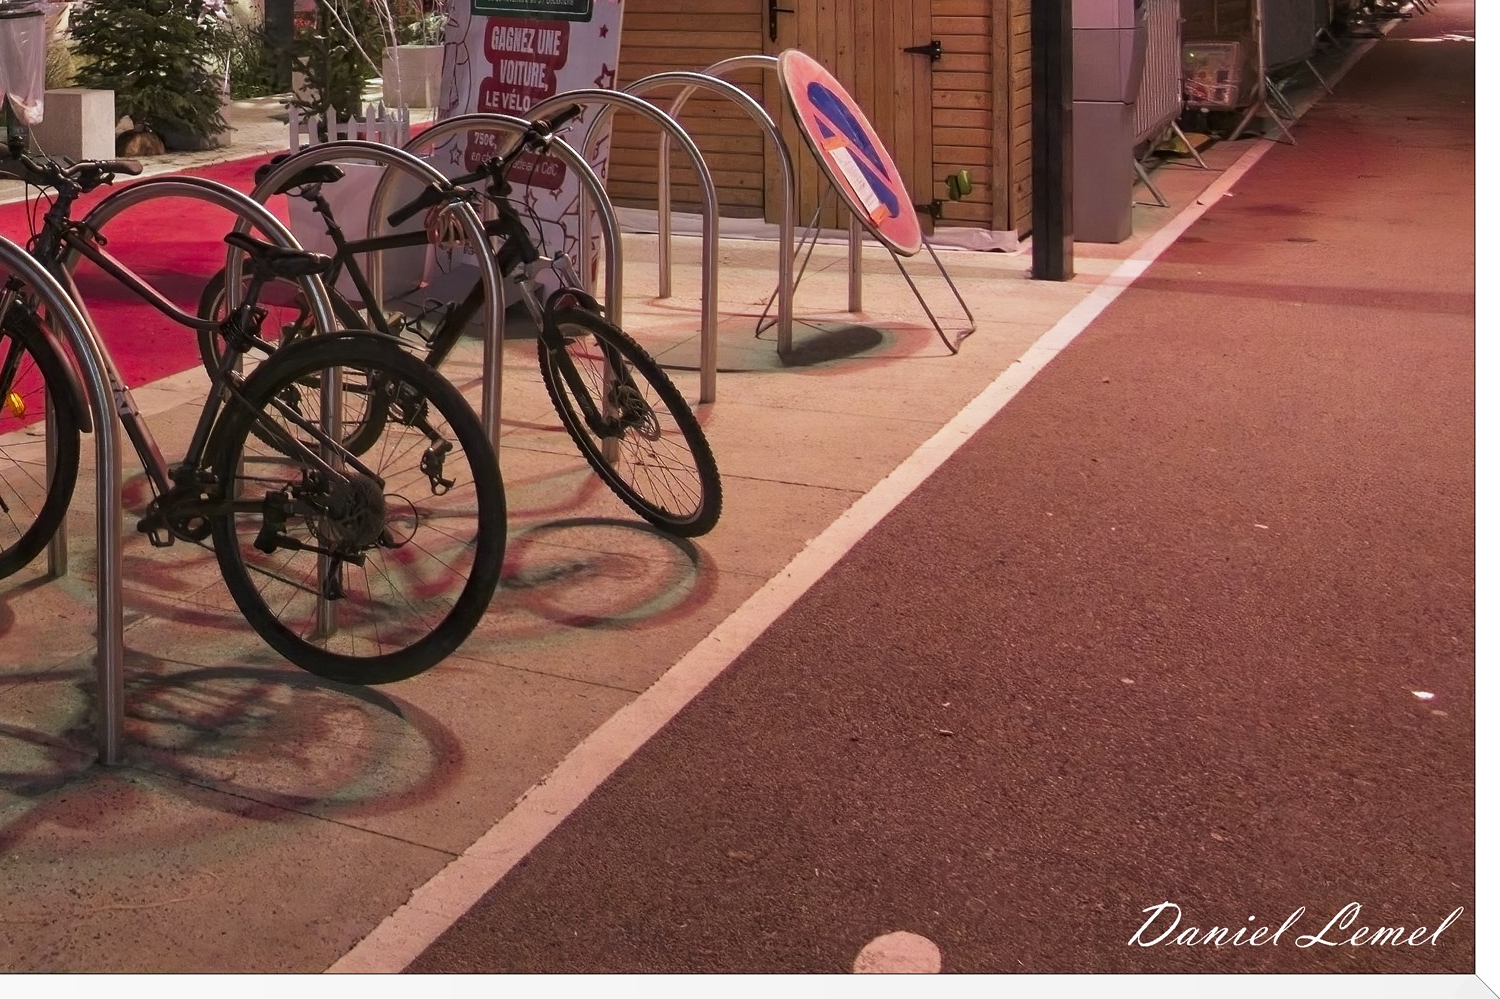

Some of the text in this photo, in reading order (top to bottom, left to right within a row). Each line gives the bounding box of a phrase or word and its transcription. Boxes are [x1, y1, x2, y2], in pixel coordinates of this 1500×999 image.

[491, 26, 562, 56] GAGNEZ UNE
[500, 59, 548, 92] VOITURE,
[485, 88, 531, 112] LE VÉLO
[474, 131, 497, 150] 750€,
[471, 152, 481, 161] en
